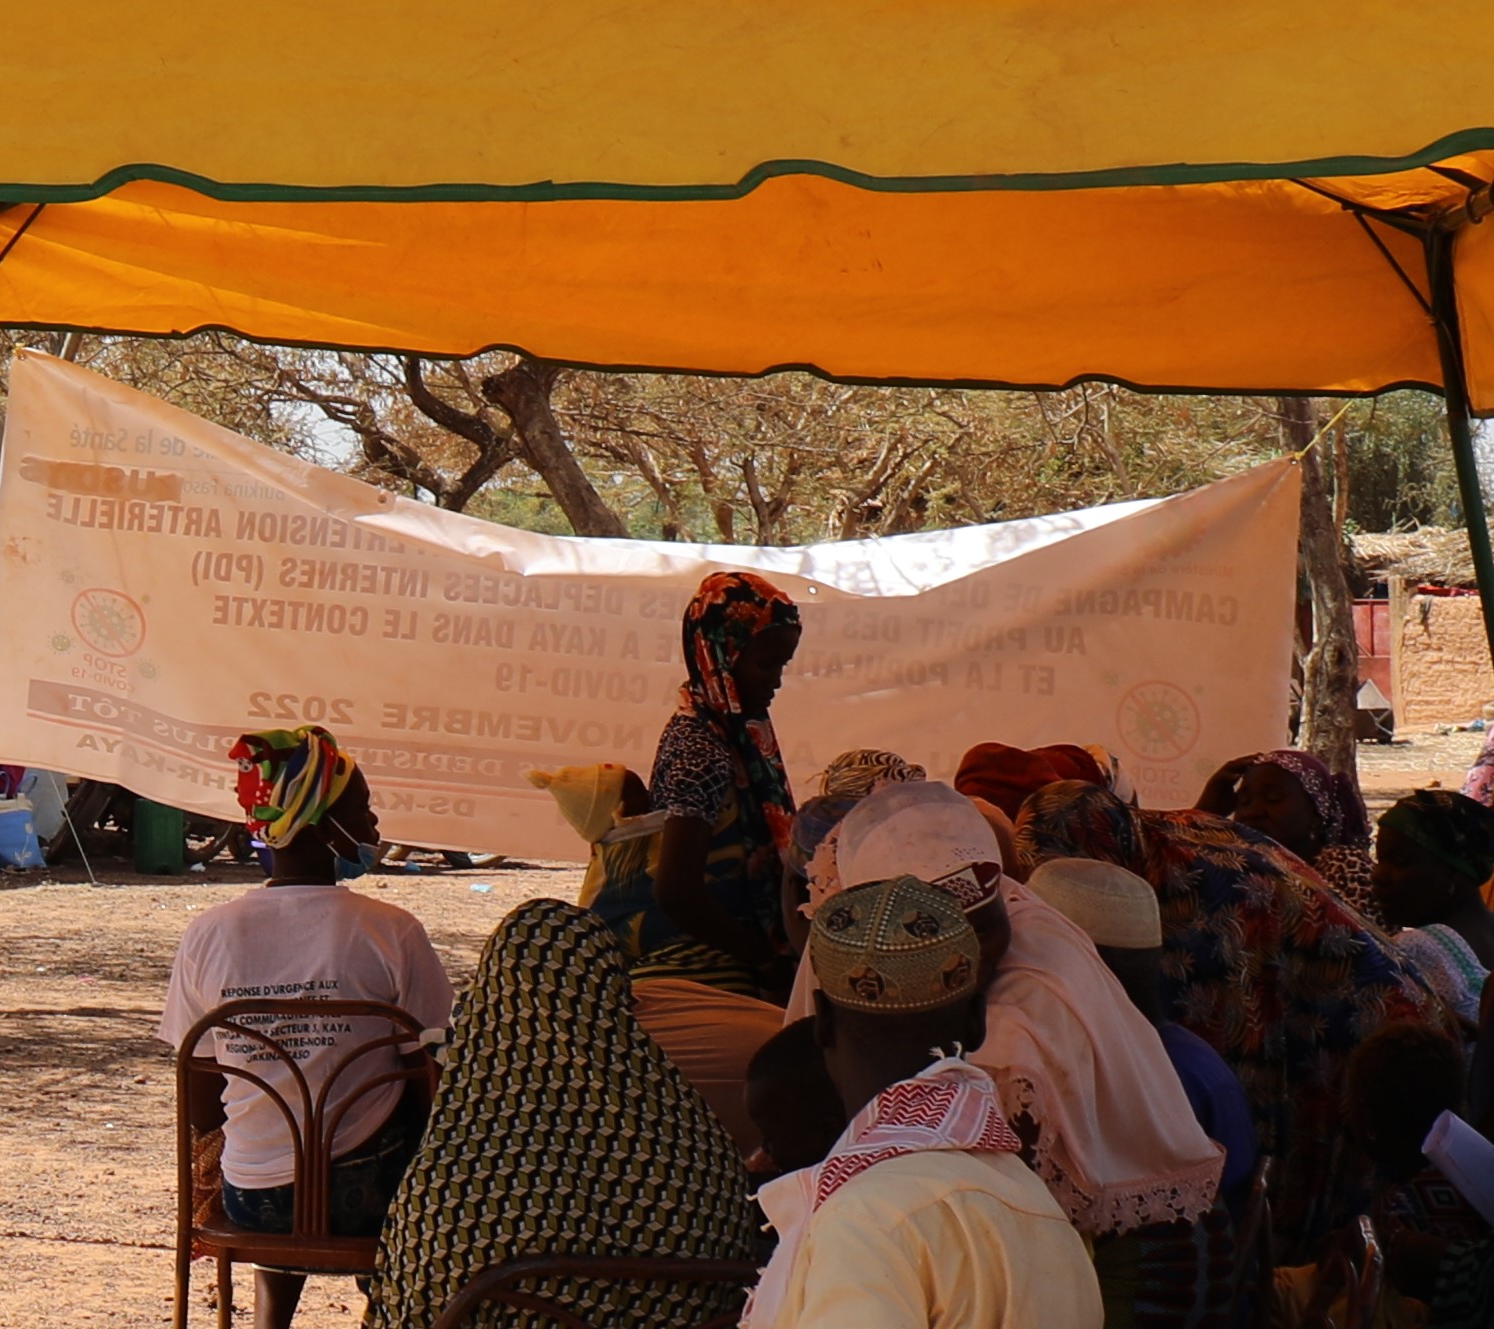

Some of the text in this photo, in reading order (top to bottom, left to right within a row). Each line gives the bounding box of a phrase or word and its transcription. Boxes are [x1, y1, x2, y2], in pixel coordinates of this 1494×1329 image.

[220, 980, 339, 998] REPONSE D'URGENCE AUX
[270, 1024, 309, 1037] SECTEUR
[322, 1023, 352, 1033] KAYA
